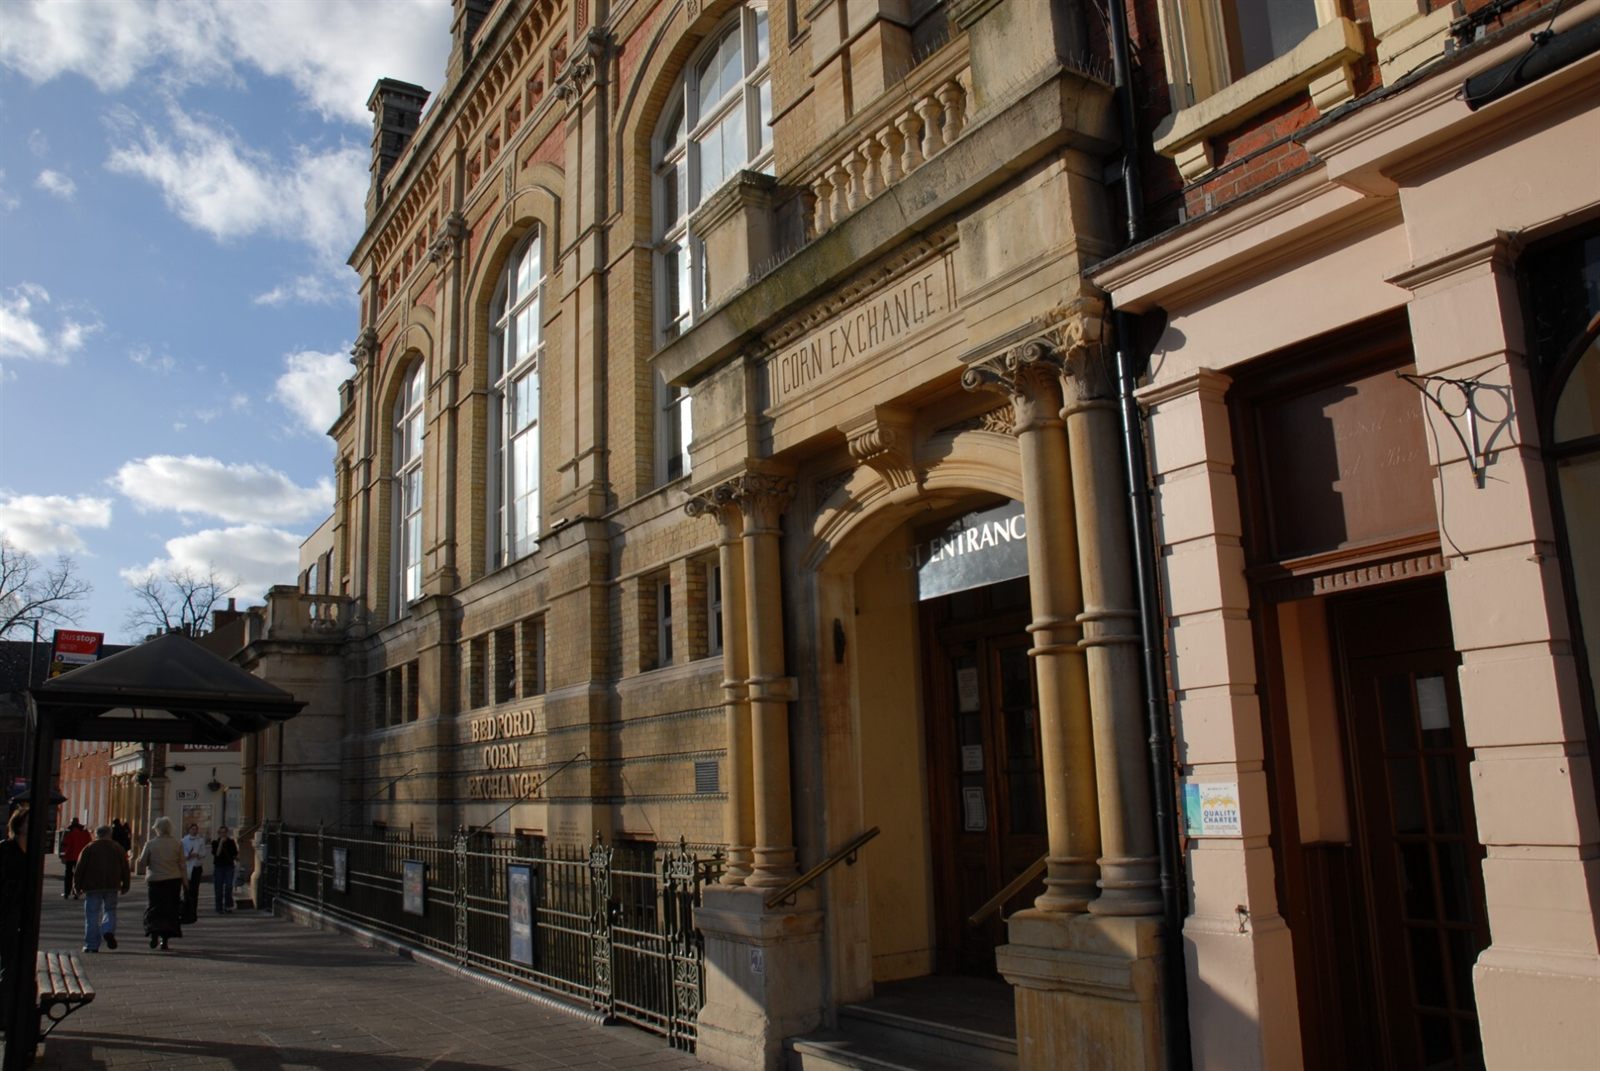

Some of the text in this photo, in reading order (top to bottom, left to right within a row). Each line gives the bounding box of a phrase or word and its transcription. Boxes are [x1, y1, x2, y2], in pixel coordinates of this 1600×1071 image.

[781, 338, 823, 395] CORN
[929, 513, 1026, 563] ENTRANC
[471, 710, 534, 742] BEDFORD
[483, 742, 520, 769] CORN
[467, 773, 542, 800] EXCHANGE
[1203, 809, 1236, 817] QUALITY
[1203, 816, 1238, 824] CHARTER
